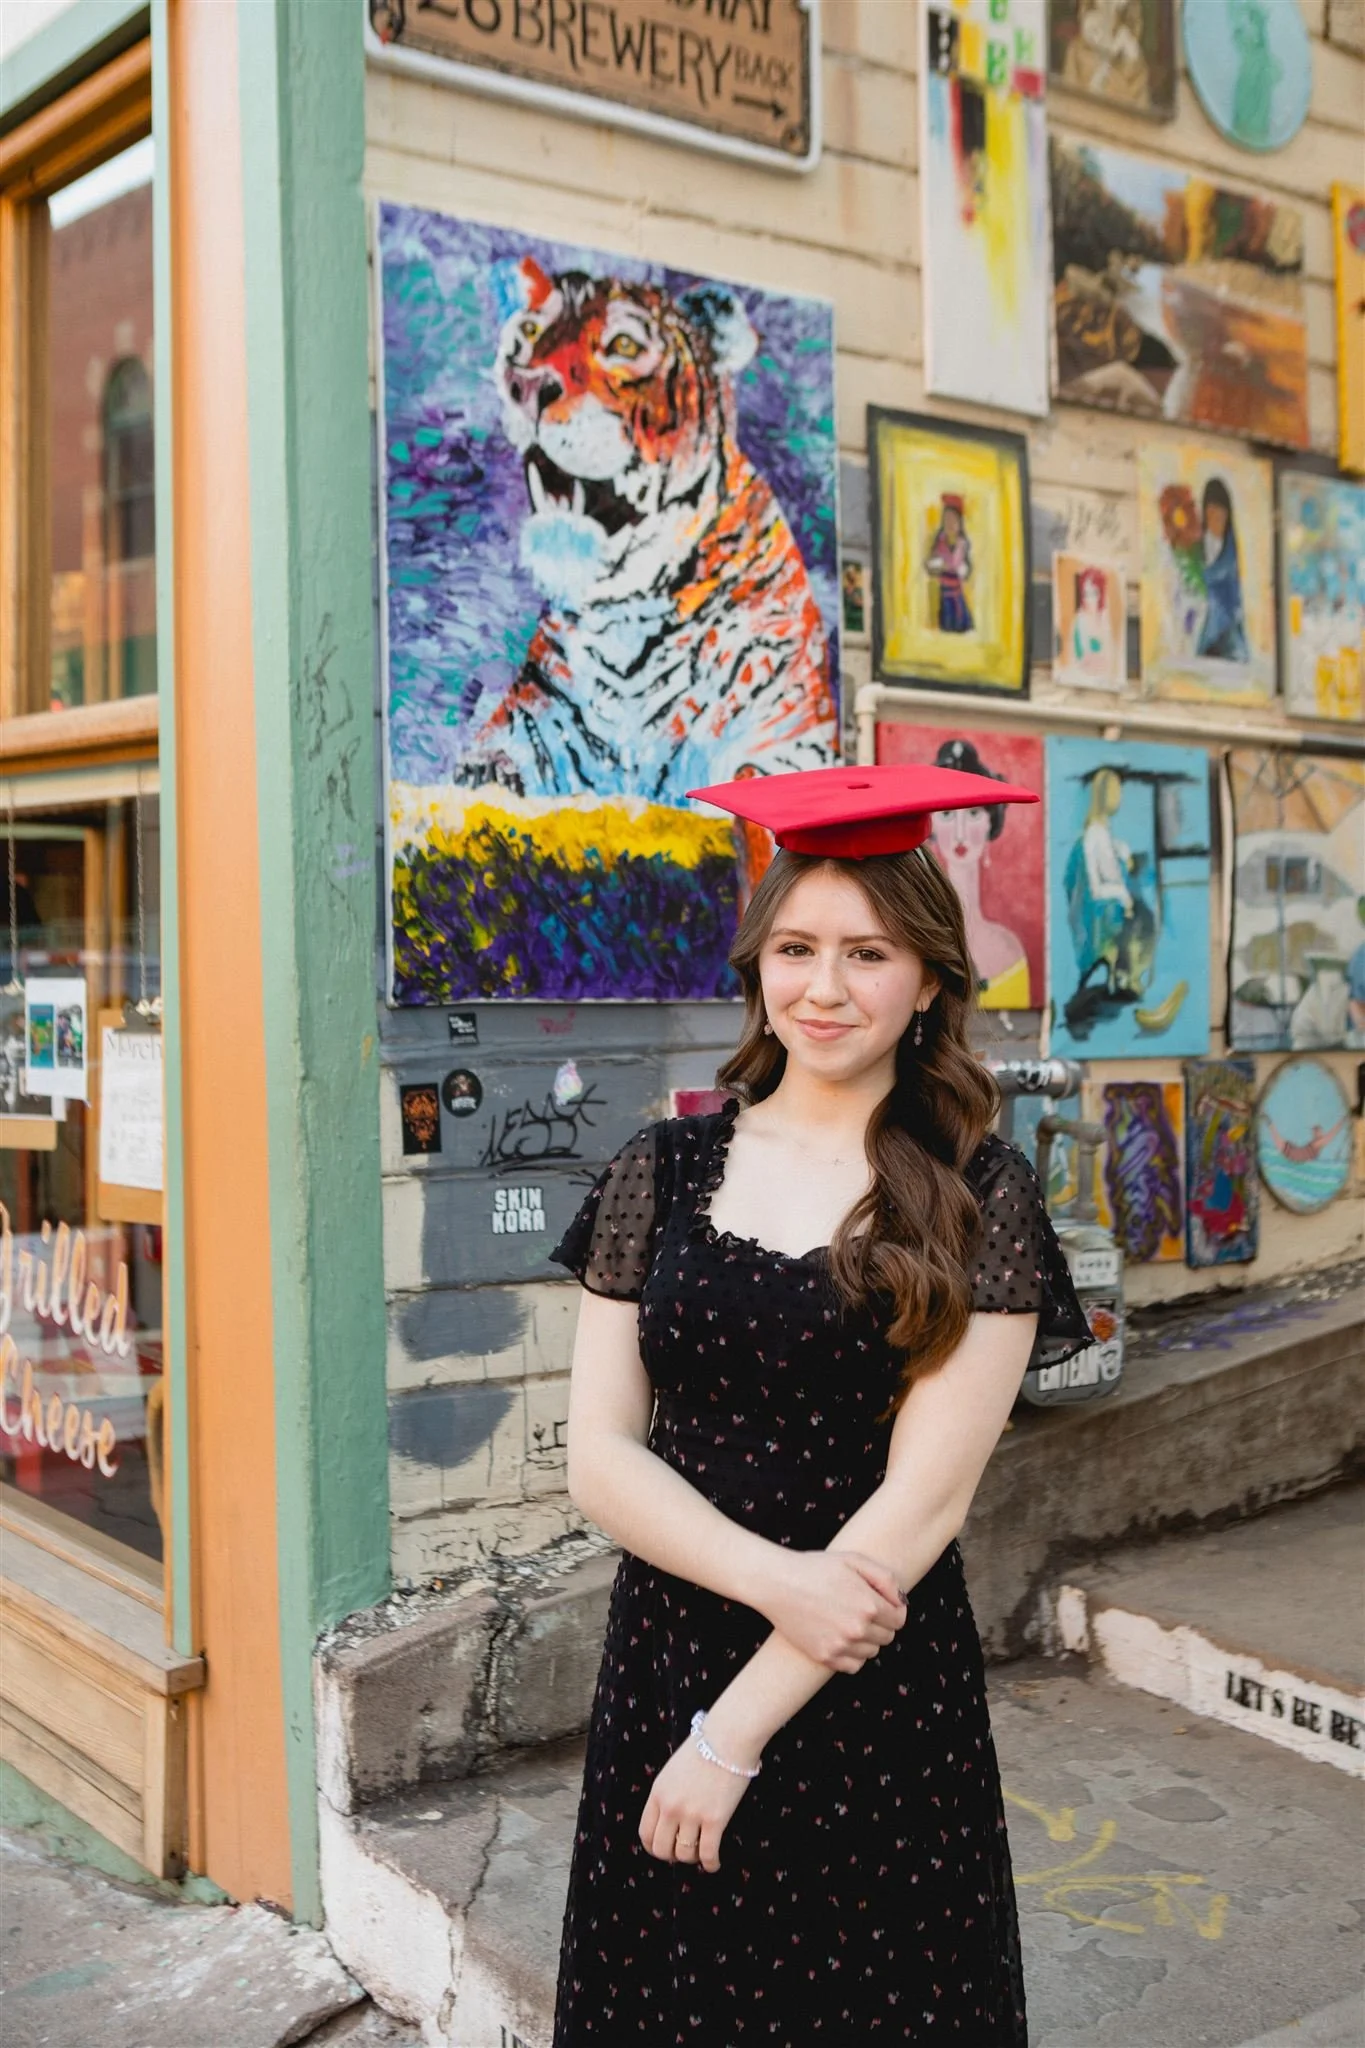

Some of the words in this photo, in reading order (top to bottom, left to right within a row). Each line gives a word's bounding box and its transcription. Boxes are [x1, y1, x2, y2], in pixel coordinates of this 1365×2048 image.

[513, 0, 733, 108] BREWERY
[495, 1186, 542, 1211] SKIN
[1291, 1695, 1323, 1734] BE
